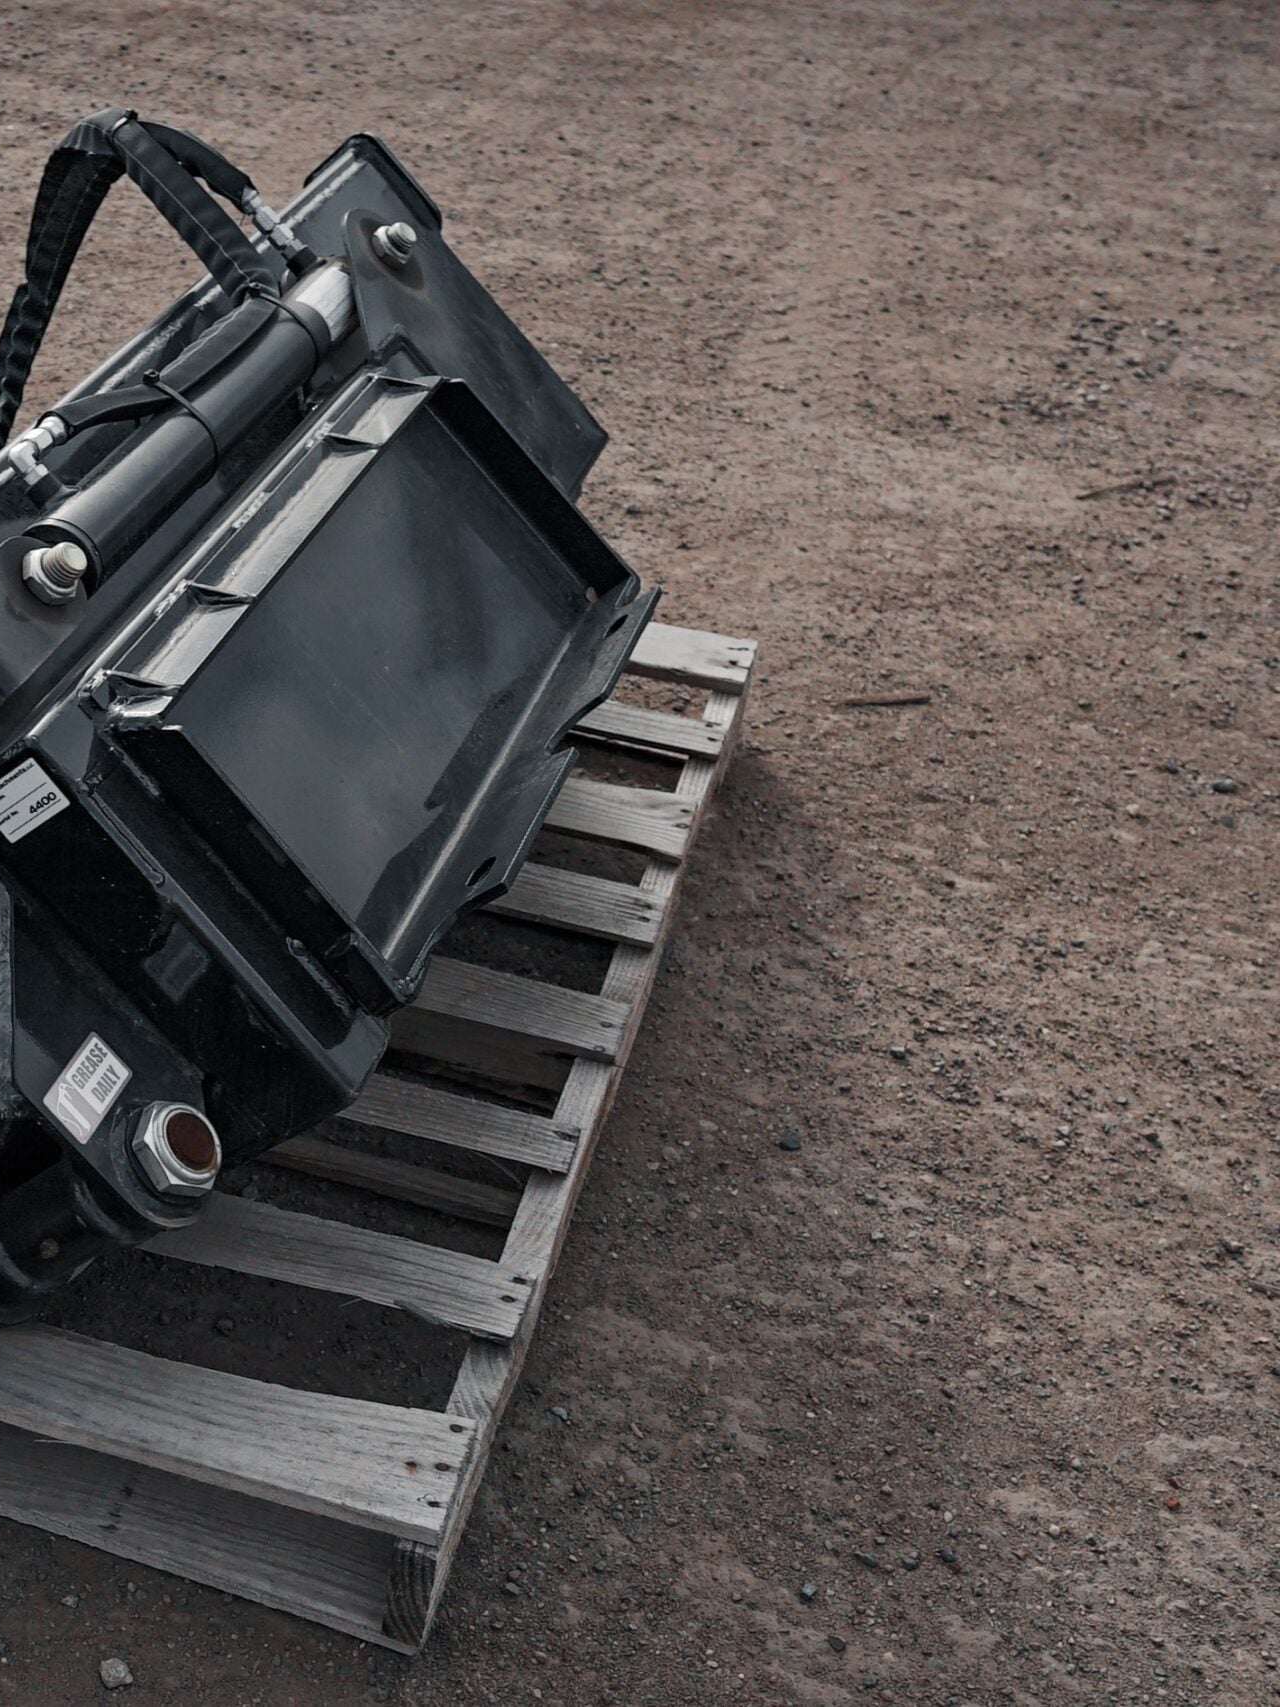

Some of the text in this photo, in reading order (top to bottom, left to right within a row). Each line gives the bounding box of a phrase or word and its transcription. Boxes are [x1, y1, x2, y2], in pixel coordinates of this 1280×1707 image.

[29, 791, 57, 815] 4400
[71, 1042, 108, 1090] GREASE
[91, 1064, 121, 1104] DAILY
